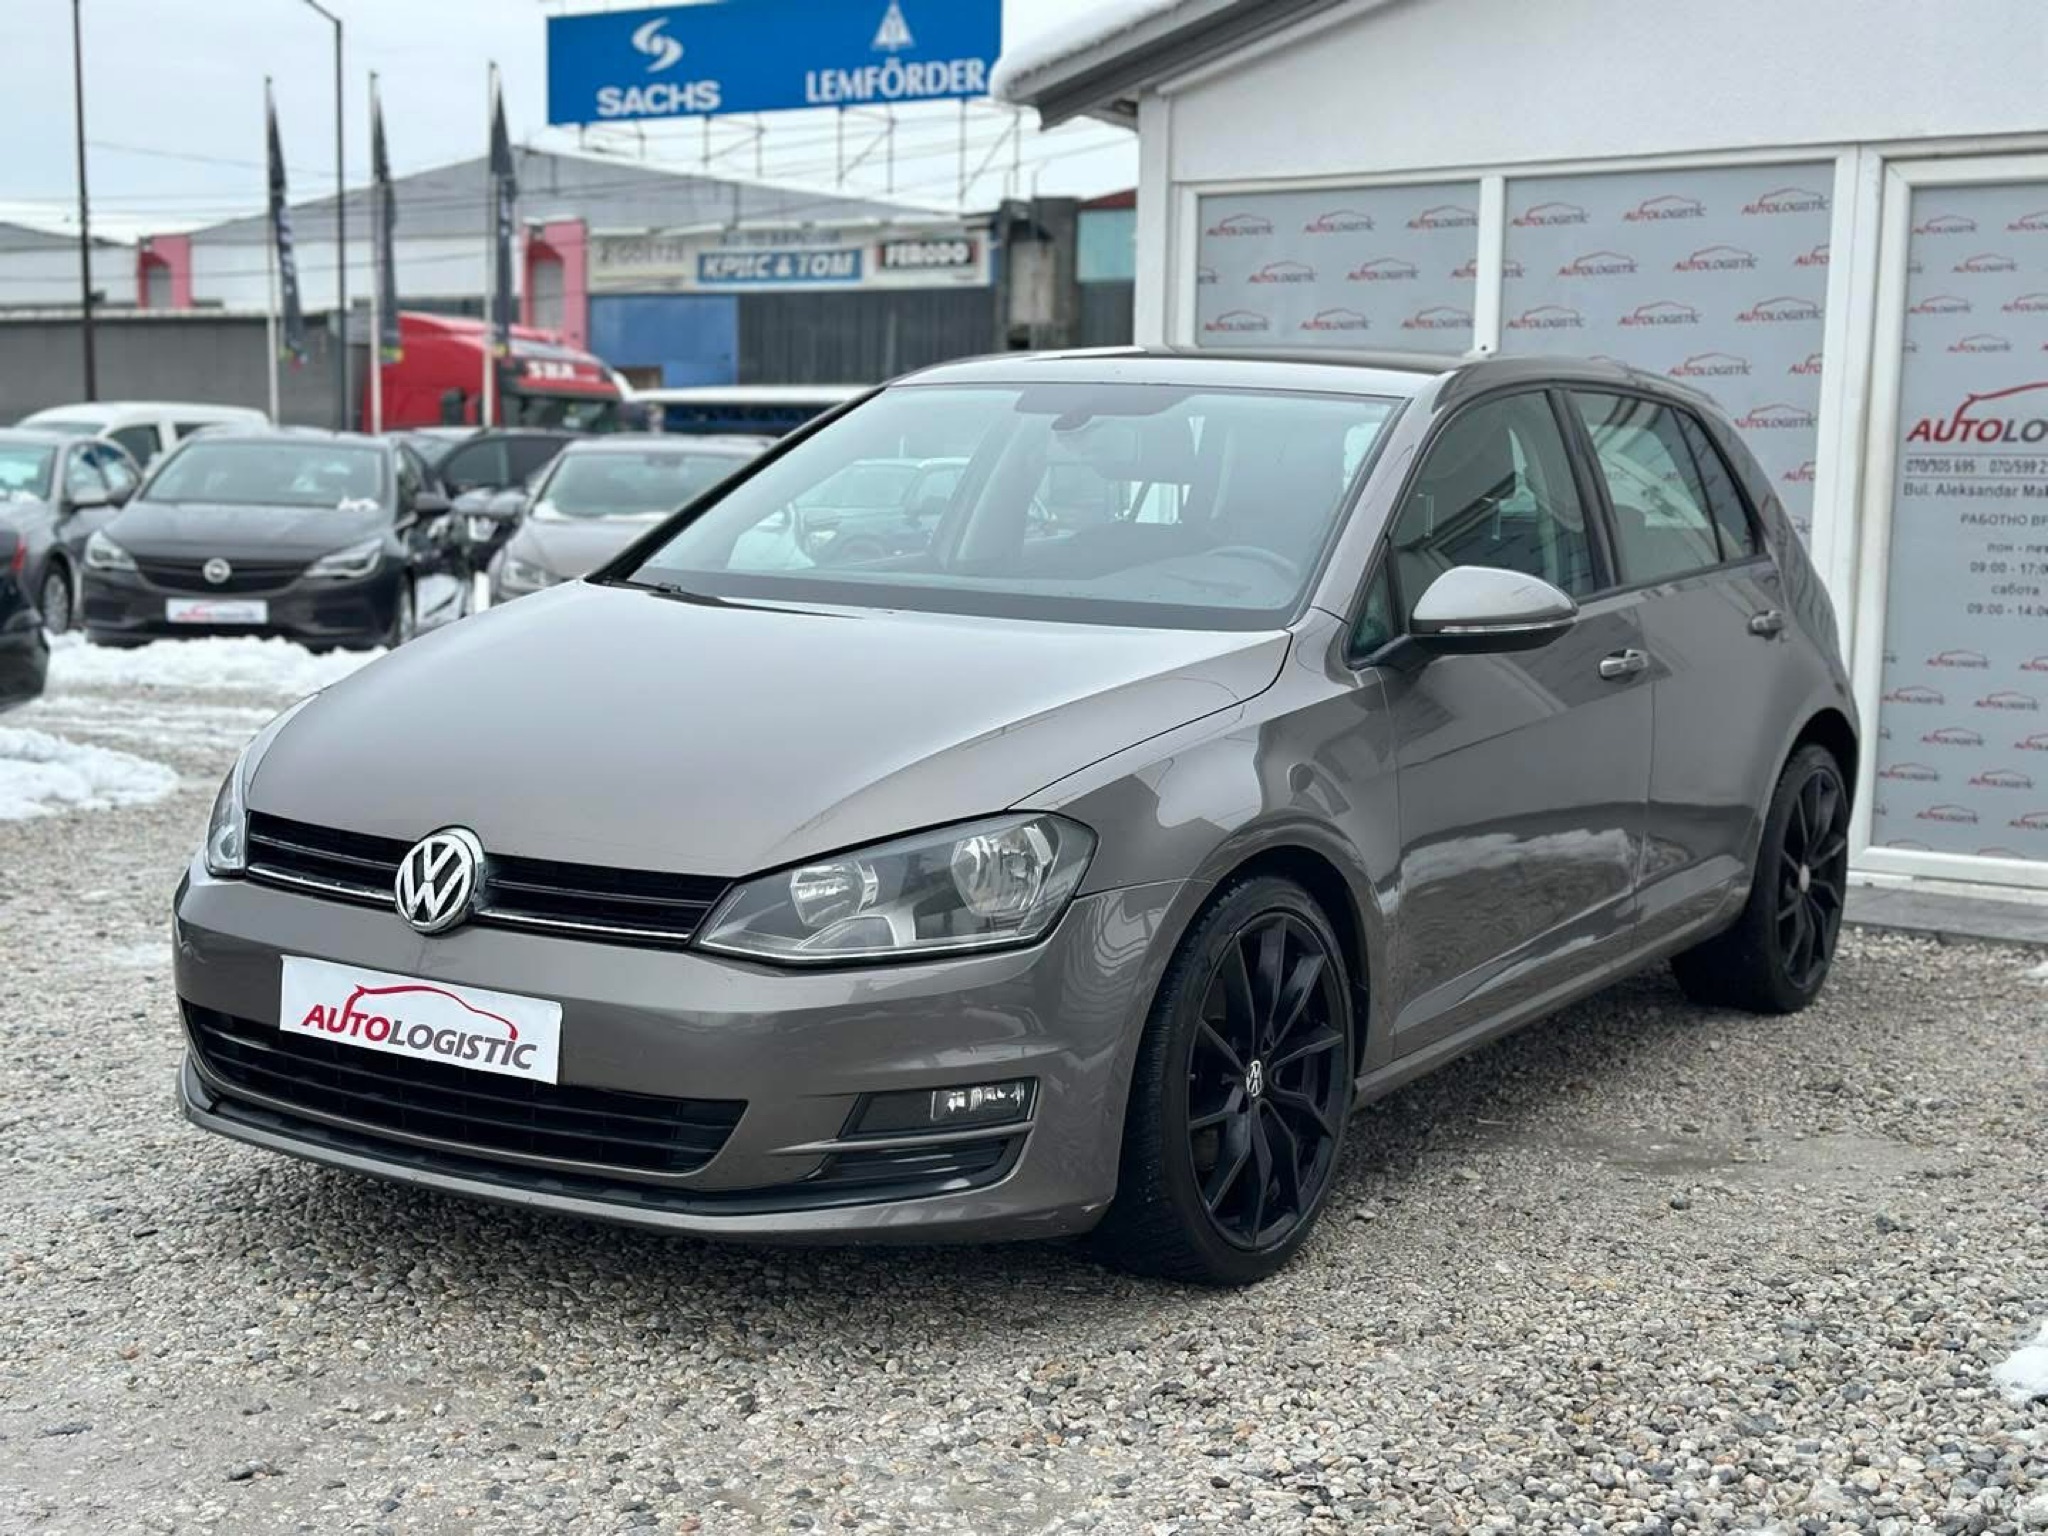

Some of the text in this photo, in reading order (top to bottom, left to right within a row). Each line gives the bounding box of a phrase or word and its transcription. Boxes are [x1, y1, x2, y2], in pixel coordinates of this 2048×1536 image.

[806, 57, 986, 103] LEMFÖRDER
[596, 80, 721, 117] SACHS
[1906, 418, 2048, 442] AUTOLO
[1935, 482, 2018, 498] Aleksandar
[1960, 513, 2027, 526] РАБОТНО
[1990, 581, 2039, 596] сабота
[301, 1003, 538, 1071] AUTOLOGISTIC
